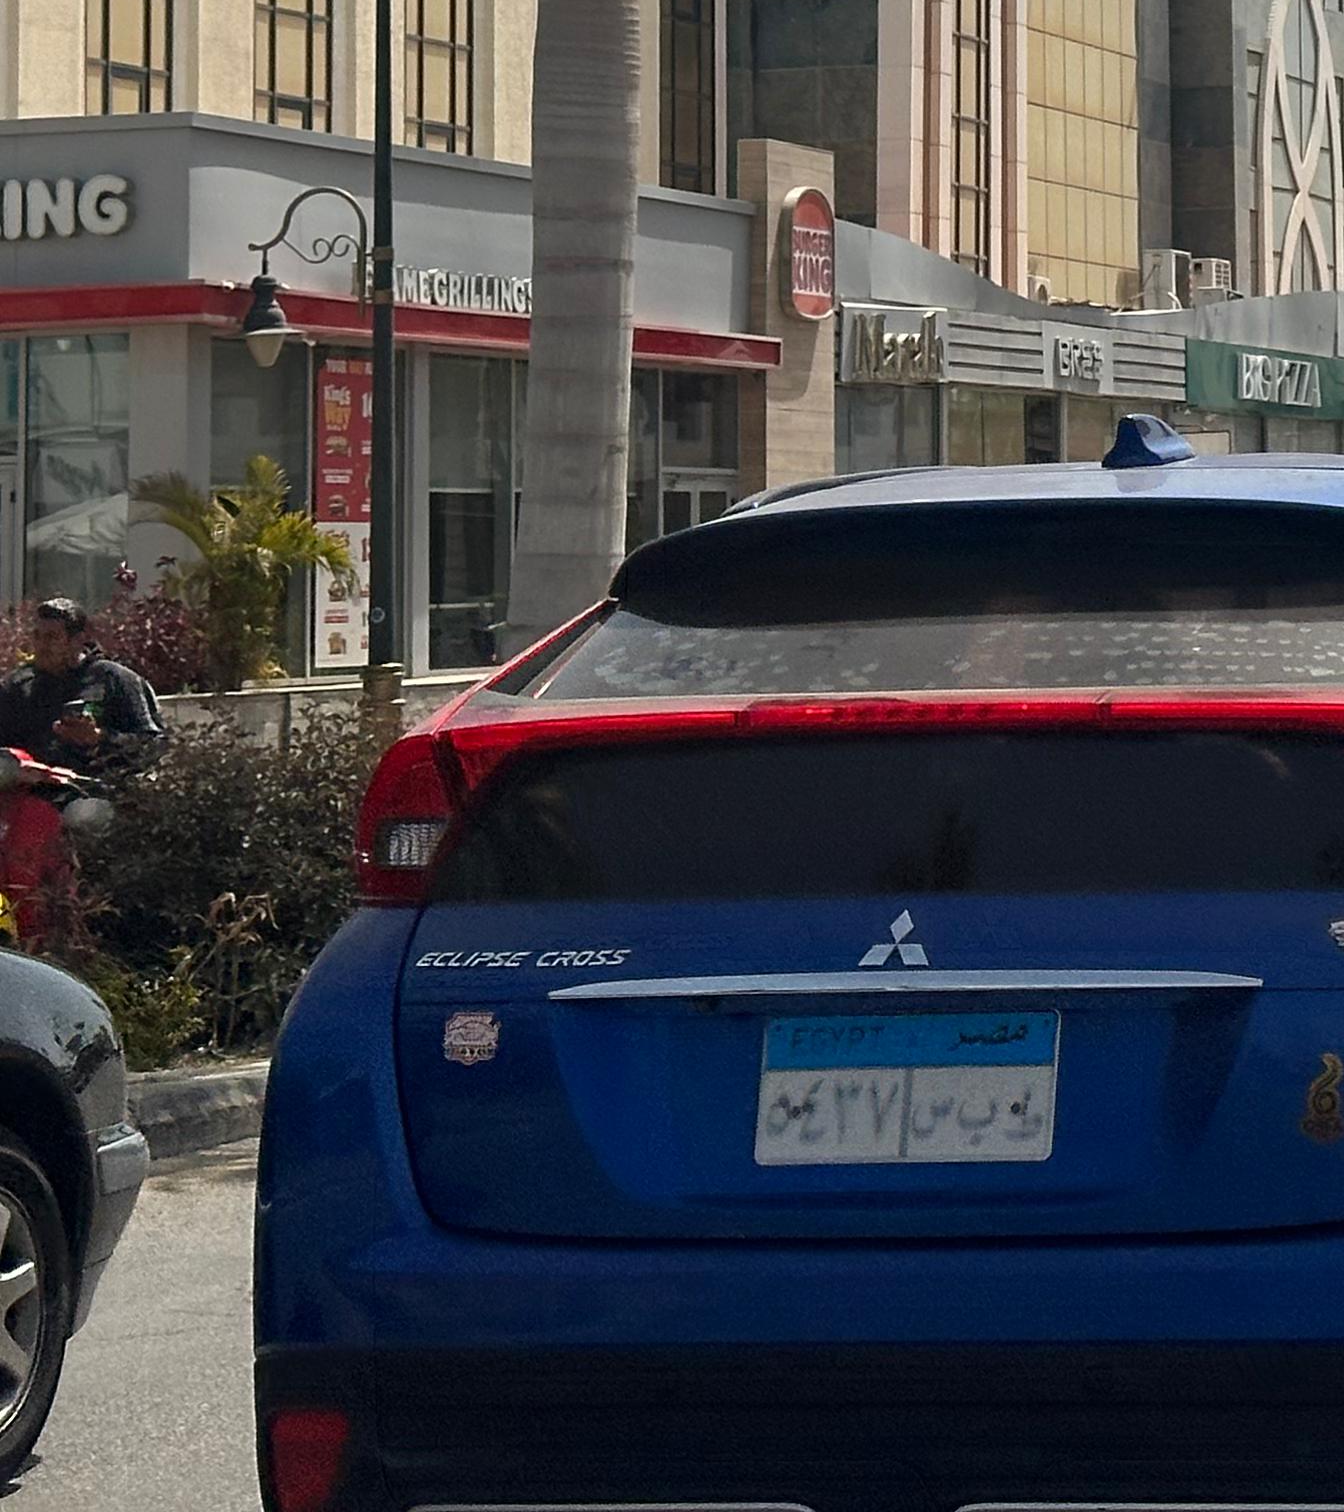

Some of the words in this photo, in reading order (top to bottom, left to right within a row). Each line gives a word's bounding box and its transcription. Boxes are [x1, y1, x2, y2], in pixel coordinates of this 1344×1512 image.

[0, 174, 129, 240] ING
[792, 256, 832, 296] KING
[416, 951, 533, 968] ECLIPSE
[536, 949, 632, 968] CROSS
